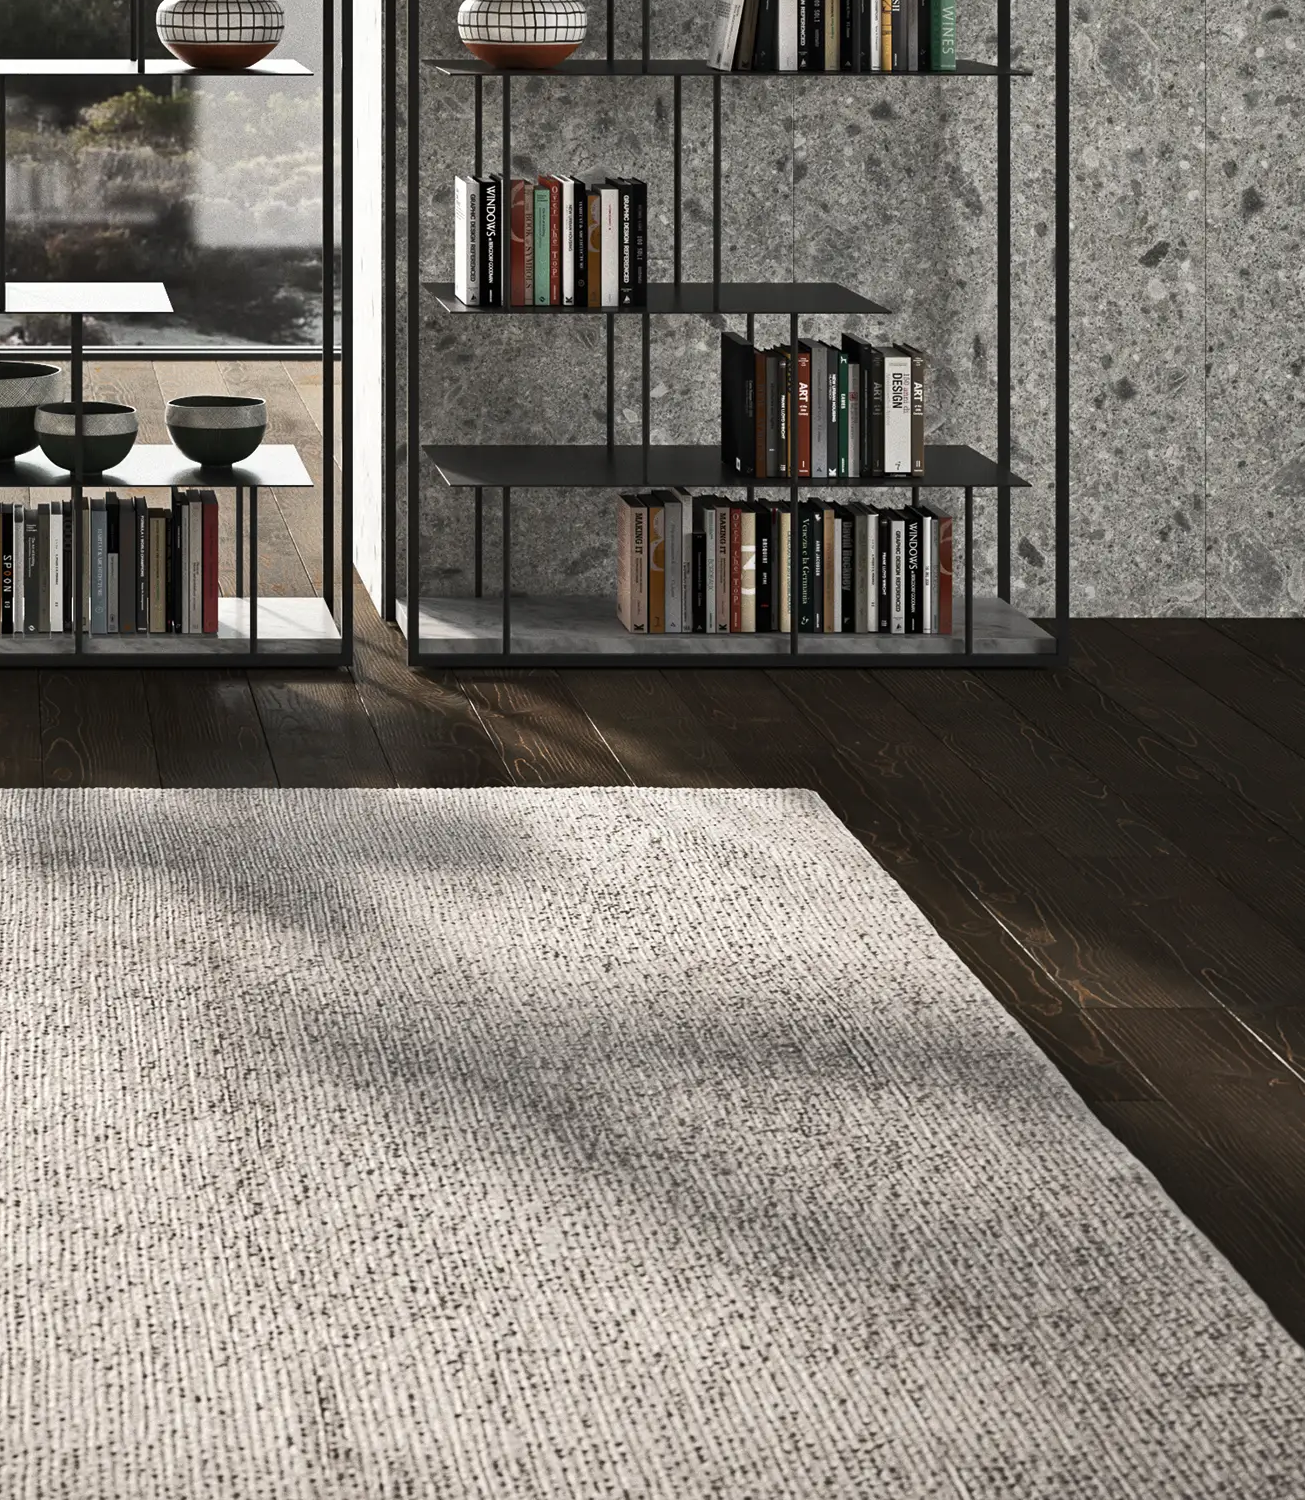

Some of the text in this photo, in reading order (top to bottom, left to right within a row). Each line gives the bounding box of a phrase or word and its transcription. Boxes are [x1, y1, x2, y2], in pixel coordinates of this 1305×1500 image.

[942, 6, 953, 54] WINES
[486, 186, 496, 236] WINDOWS
[799, 382, 808, 402] ART
[874, 382, 882, 401] ART
[892, 373, 902, 409] DESIGN
[914, 382, 922, 402] ART
[635, 546, 642, 554] IT
[719, 513, 727, 554] MAKING IT
[802, 519, 810, 549] Venezia
[842, 521, 852, 548] David
[909, 522, 917, 569] WINDOWS
[3, 555, 12, 592] SPOON
[802, 566, 810, 604] Germania
